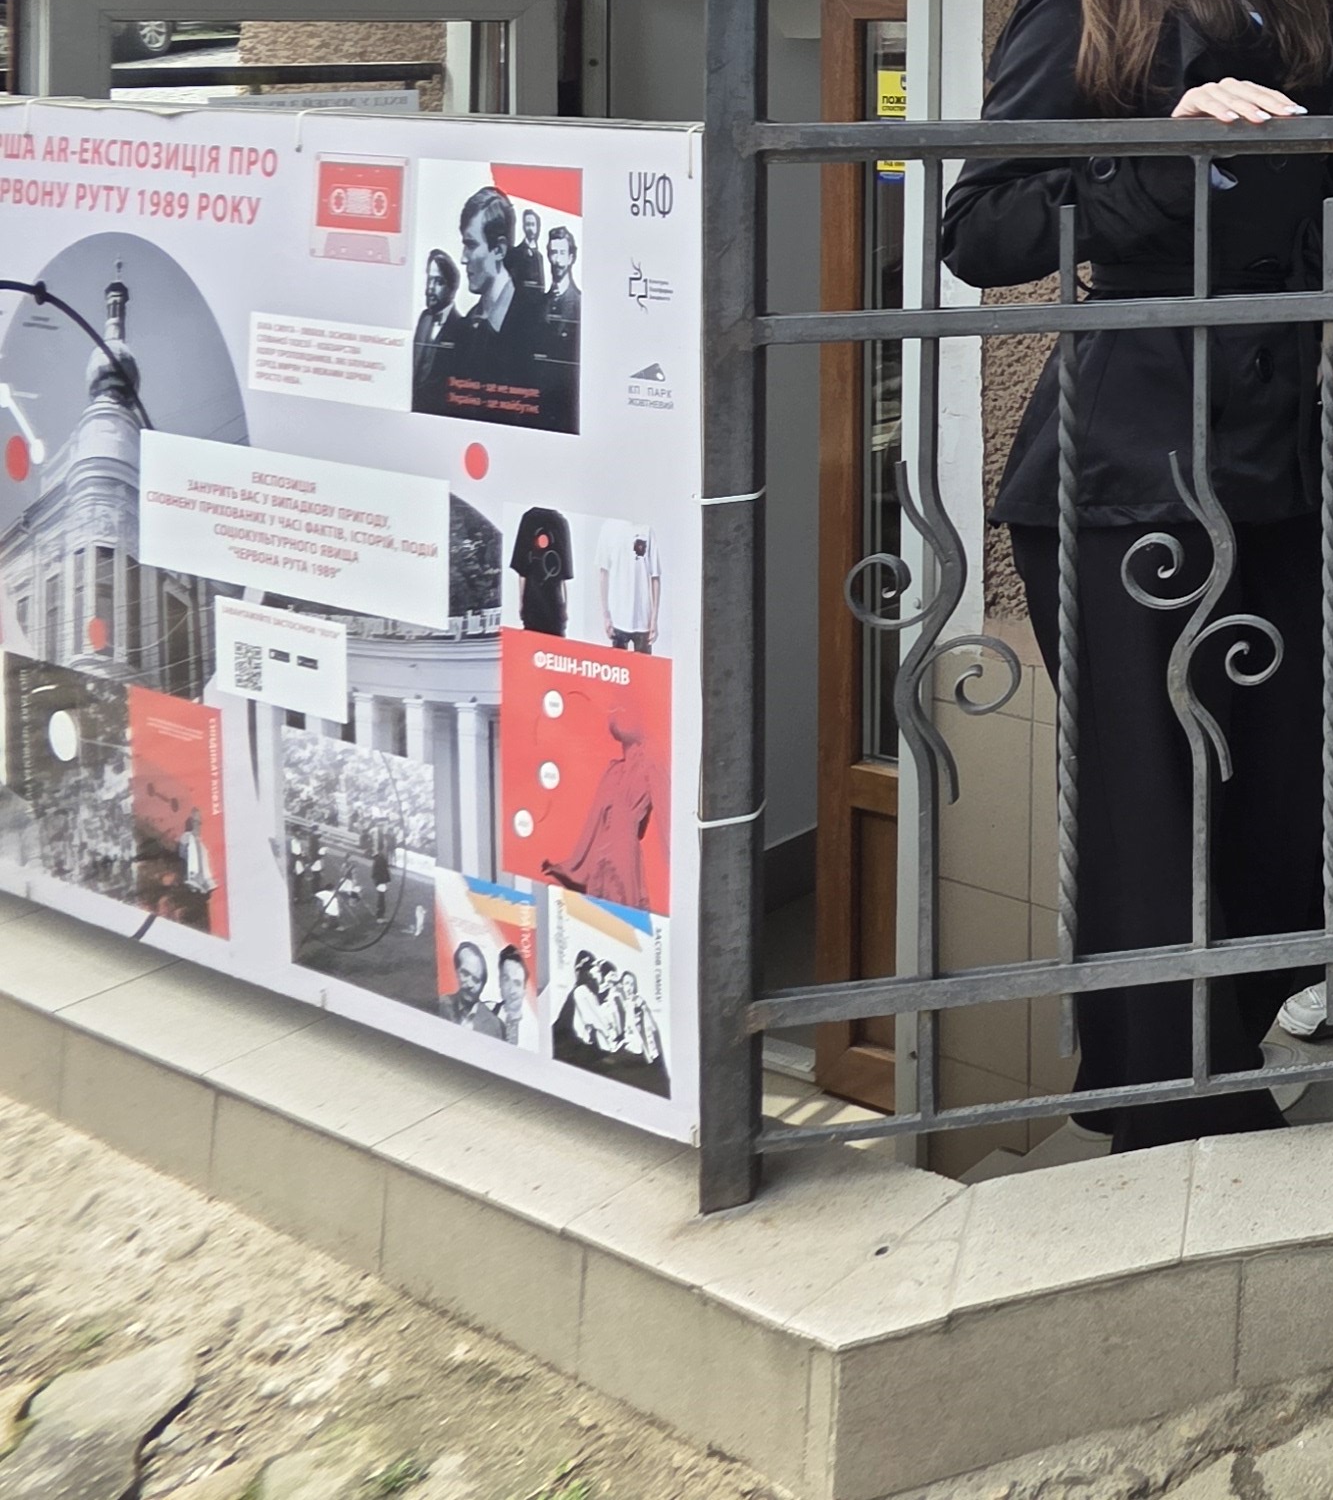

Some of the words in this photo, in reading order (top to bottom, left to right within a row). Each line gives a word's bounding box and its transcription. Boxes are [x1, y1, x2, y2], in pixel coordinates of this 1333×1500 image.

[0, 133, 36, 160] ША
[42, 136, 221, 177] AR-ЕКСПОЗИЦІЯ
[228, 147, 278, 177] ПРО
[0, 177, 69, 208] РВОНУ
[75, 183, 130, 213] РУТУ
[137, 188, 190, 219] 1989
[196, 193, 262, 225] РОКУ
[533, 650, 631, 685] ФЕШН-ПРОЯВ
